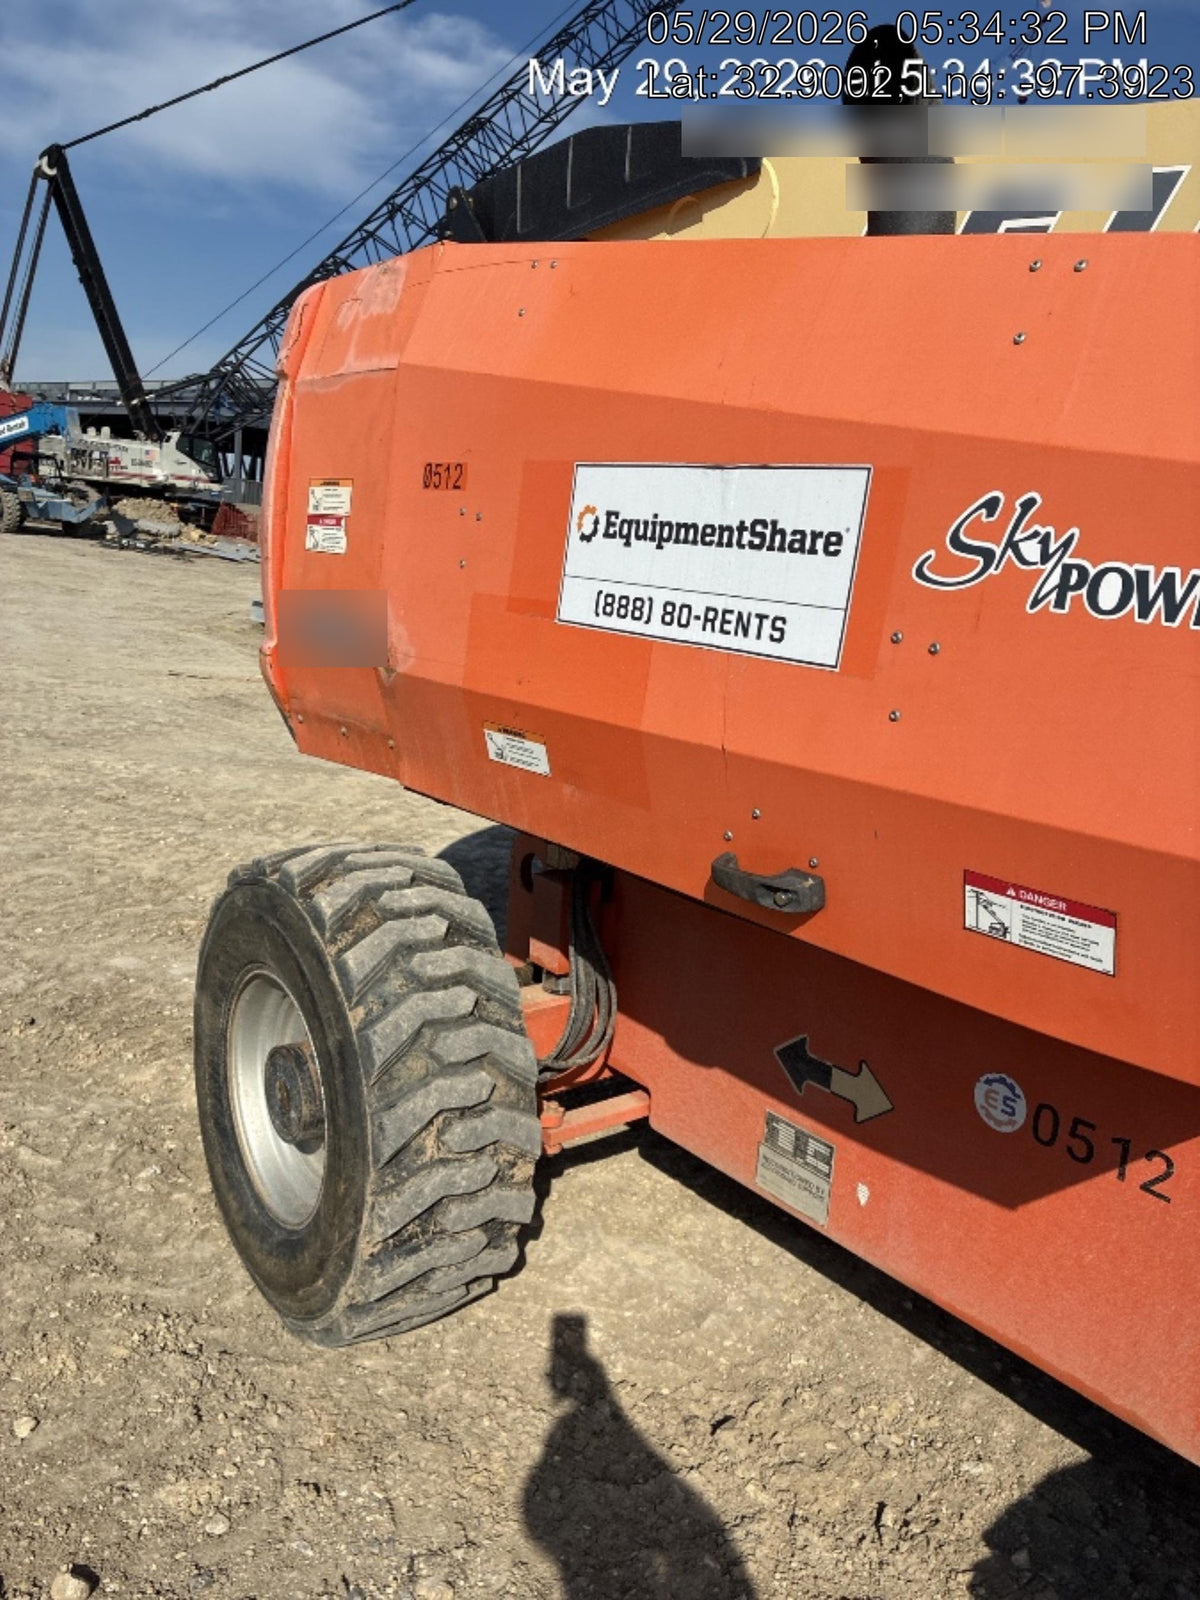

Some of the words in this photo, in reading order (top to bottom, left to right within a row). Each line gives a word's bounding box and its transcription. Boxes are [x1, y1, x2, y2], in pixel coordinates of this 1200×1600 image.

[423, 463, 464, 490] 0512
[602, 509, 844, 558] EquipmentShare
[912, 490, 1079, 613] Sky
[1052, 558, 1200, 630] POW
[594, 589, 653, 625] (888)
[660, 600, 788, 644] 80-RENTS
[1018, 888, 1068, 912] DANGER
[1032, 1102, 1176, 1204] 0512
